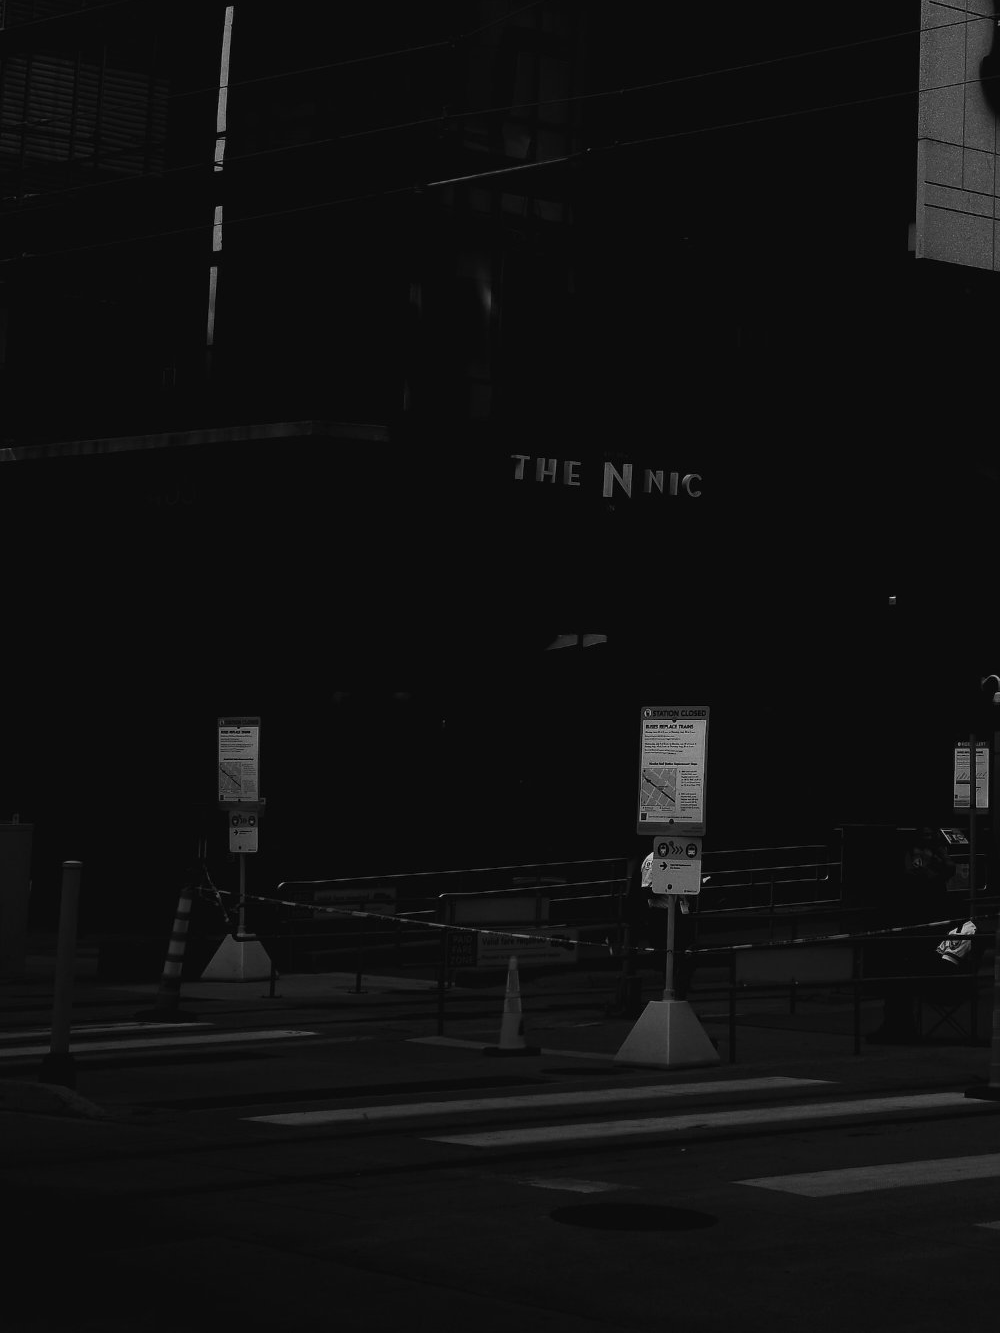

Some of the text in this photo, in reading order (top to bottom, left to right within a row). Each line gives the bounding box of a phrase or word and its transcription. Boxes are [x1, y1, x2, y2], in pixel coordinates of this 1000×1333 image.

[510, 453, 703, 499] THE N NIC
